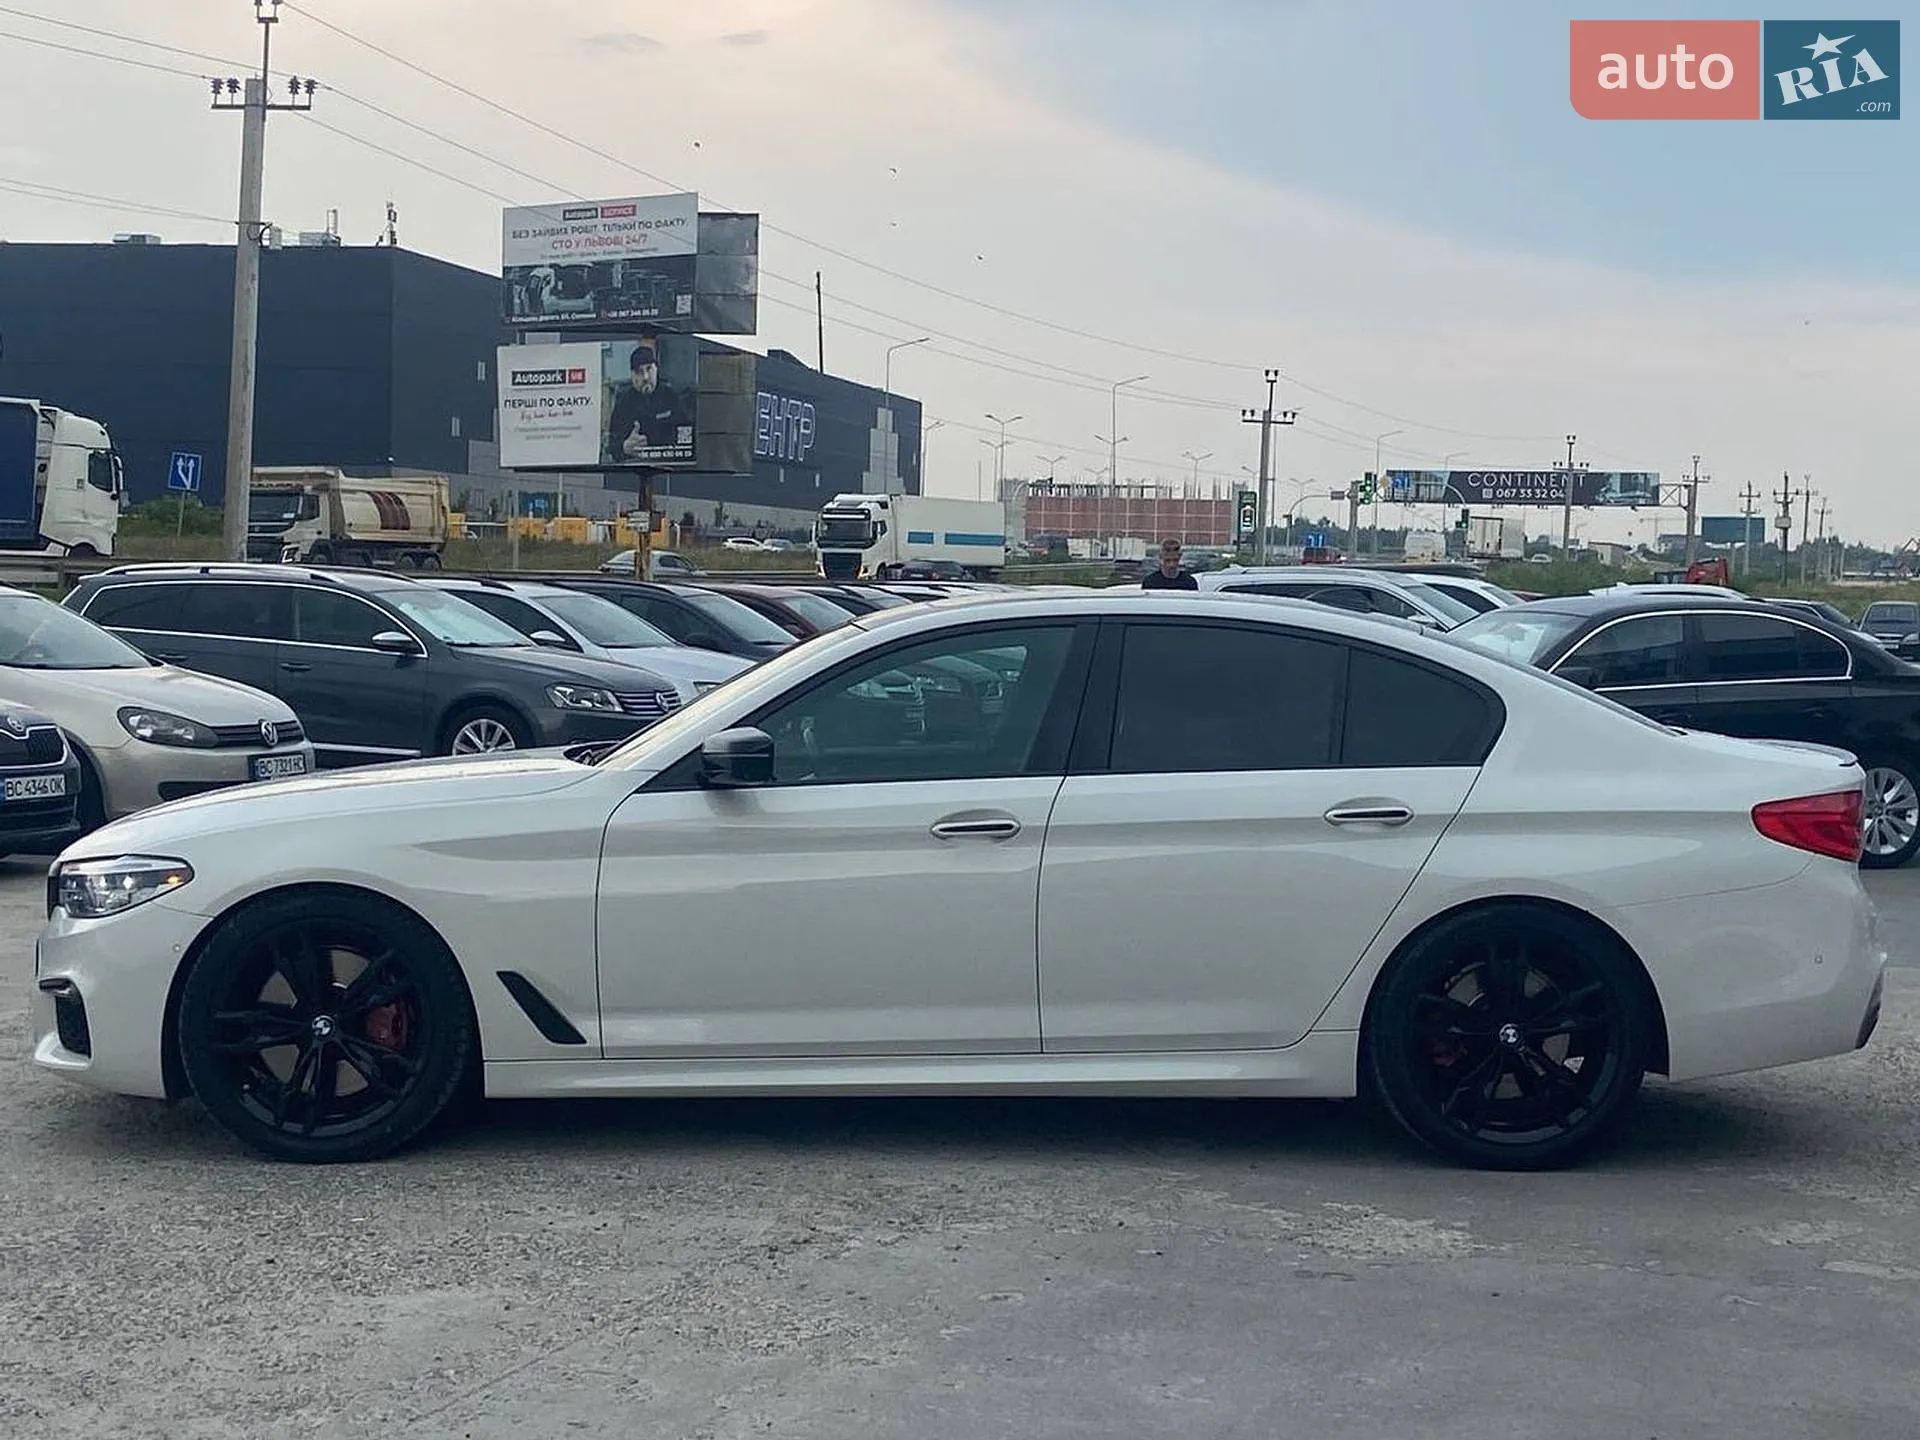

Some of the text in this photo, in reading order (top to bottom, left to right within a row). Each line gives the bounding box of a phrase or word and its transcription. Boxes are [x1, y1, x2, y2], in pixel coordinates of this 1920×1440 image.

[552, 239, 572, 250] СТО
[514, 371, 563, 384] Autopark
[504, 398, 537, 408] ПЕРШІ
[540, 397, 555, 407] ПО
[1496, 488, 1517, 498] 067
[1534, 488, 1548, 499] 32
[6, 780, 22, 797] BC
[49, 777, 64, 793] OK
